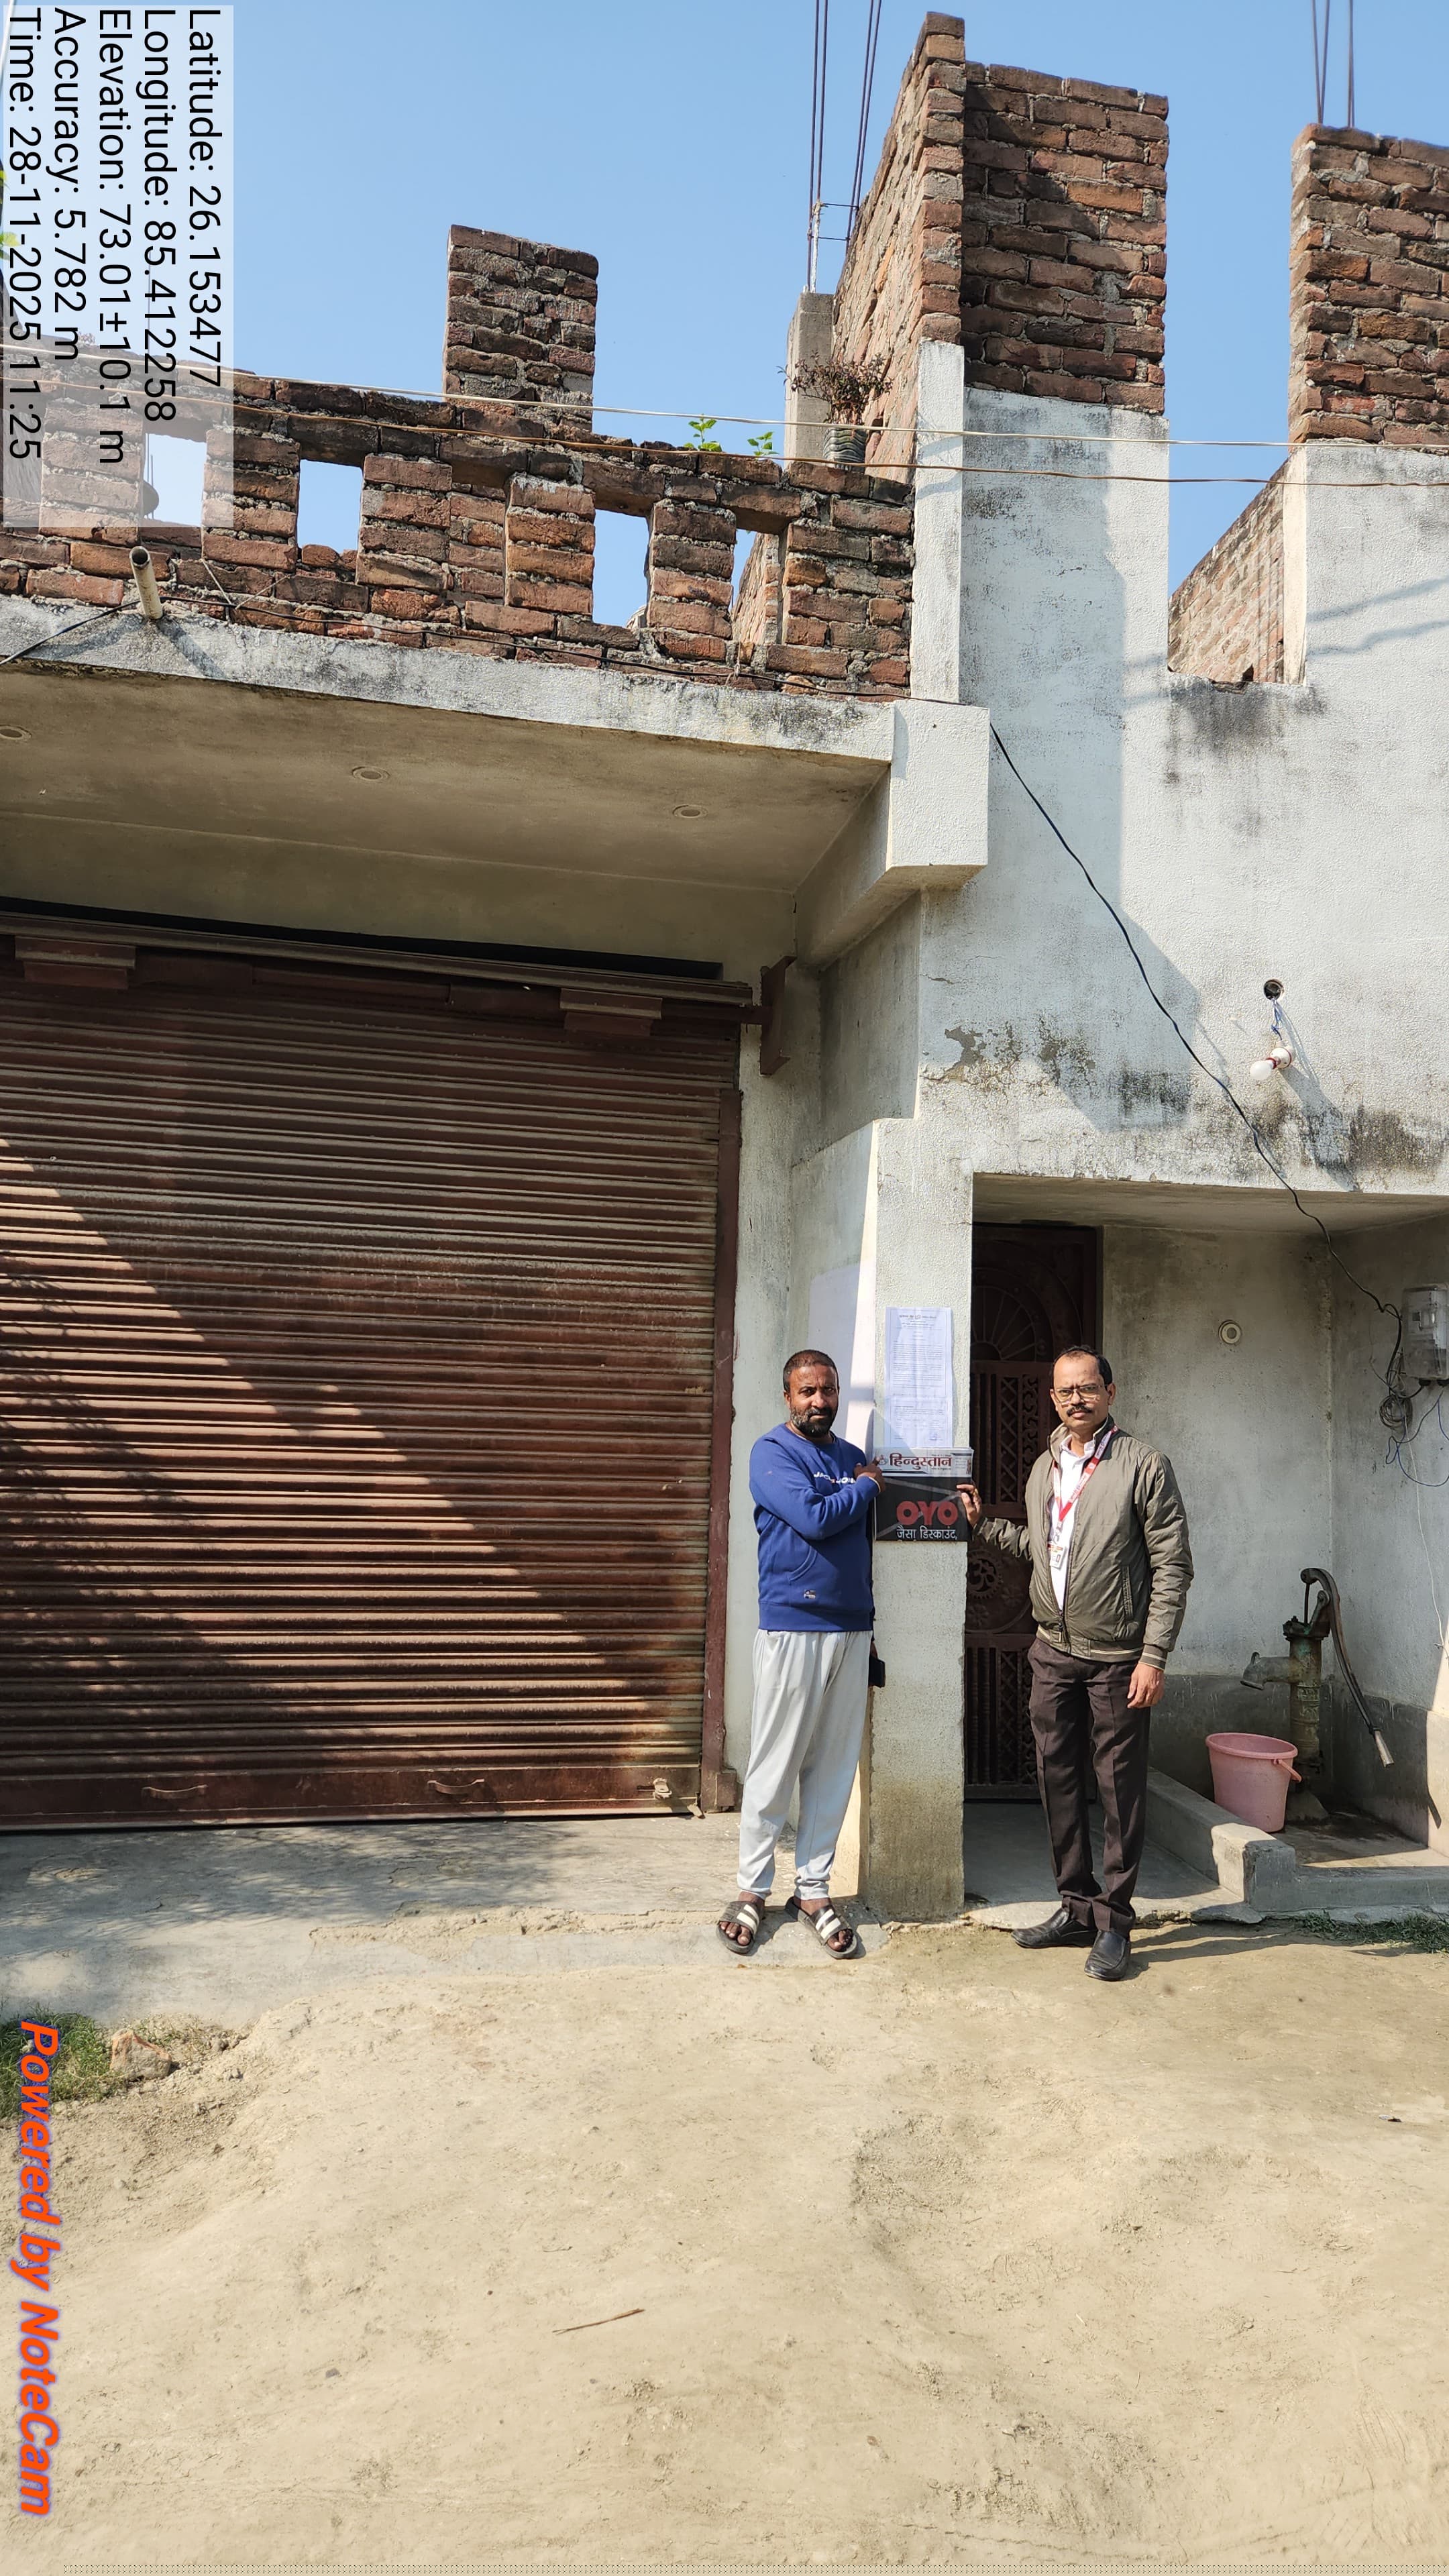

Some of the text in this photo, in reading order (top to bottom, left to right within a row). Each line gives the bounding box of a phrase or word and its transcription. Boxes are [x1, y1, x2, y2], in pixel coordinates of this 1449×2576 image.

[890, 1452, 953, 1470] हिन्दुस्तान
[896, 1501, 958, 1525] OYO
[896, 1524, 916, 1539] जैसा
